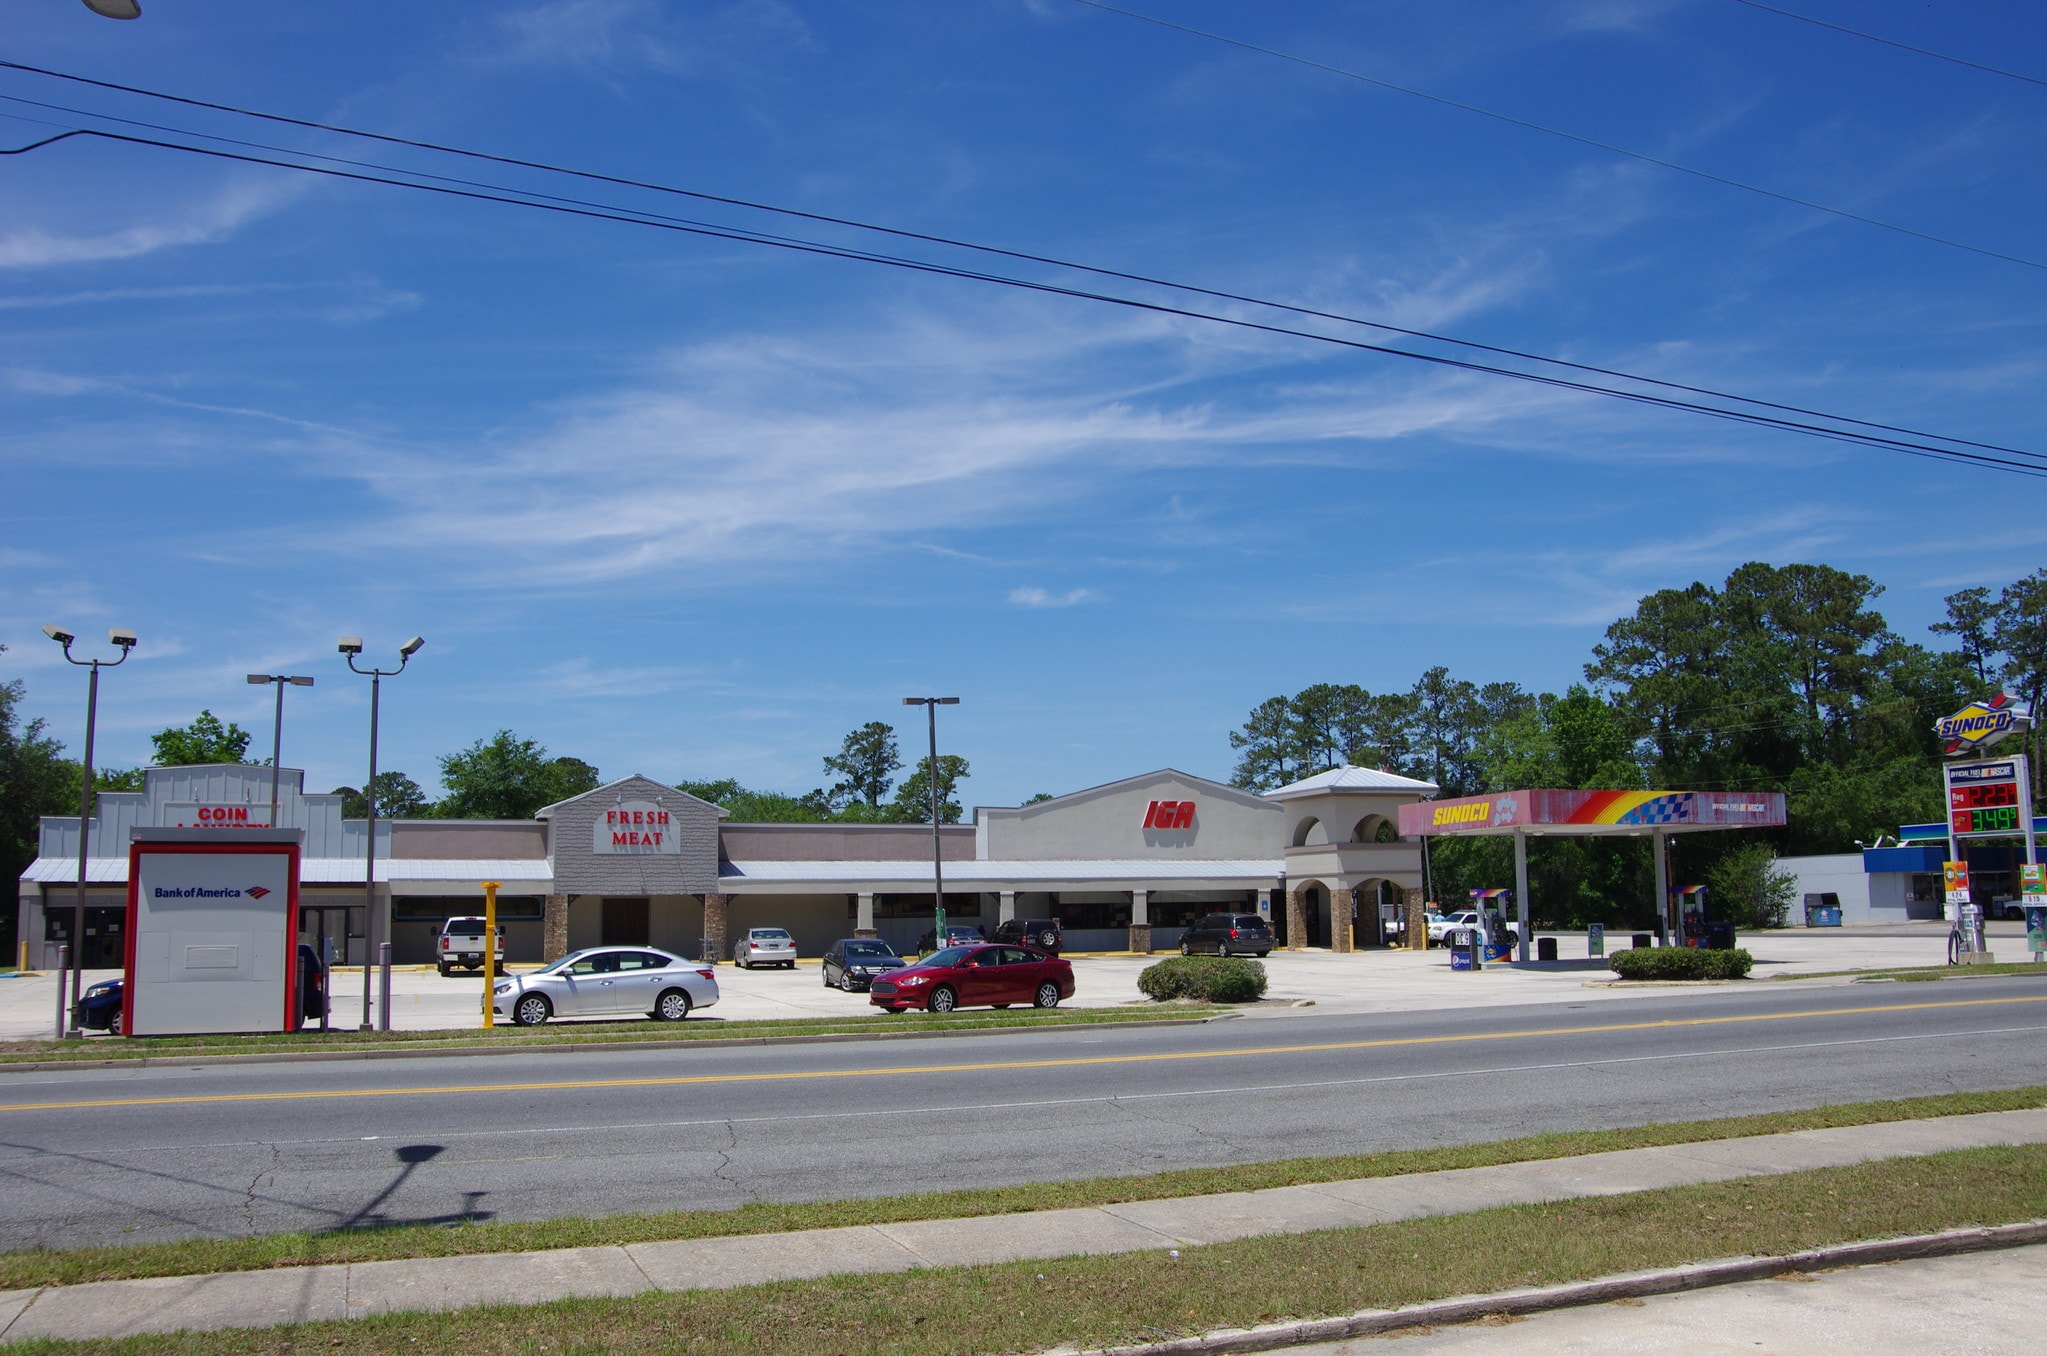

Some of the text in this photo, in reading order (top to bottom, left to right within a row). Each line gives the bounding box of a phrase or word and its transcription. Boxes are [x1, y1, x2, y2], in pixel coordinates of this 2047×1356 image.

[1941, 712, 2008, 735] SUNOCO
[1950, 769, 1970, 778] OFFICIAL
[198, 807, 247, 821] COIN
[607, 812, 669, 825] FRESH
[1141, 800, 1197, 829] IGA
[1432, 802, 1490, 826] SUNOCO
[613, 832, 663, 845] MEAT
[155, 887, 241, 898] Bank of America
